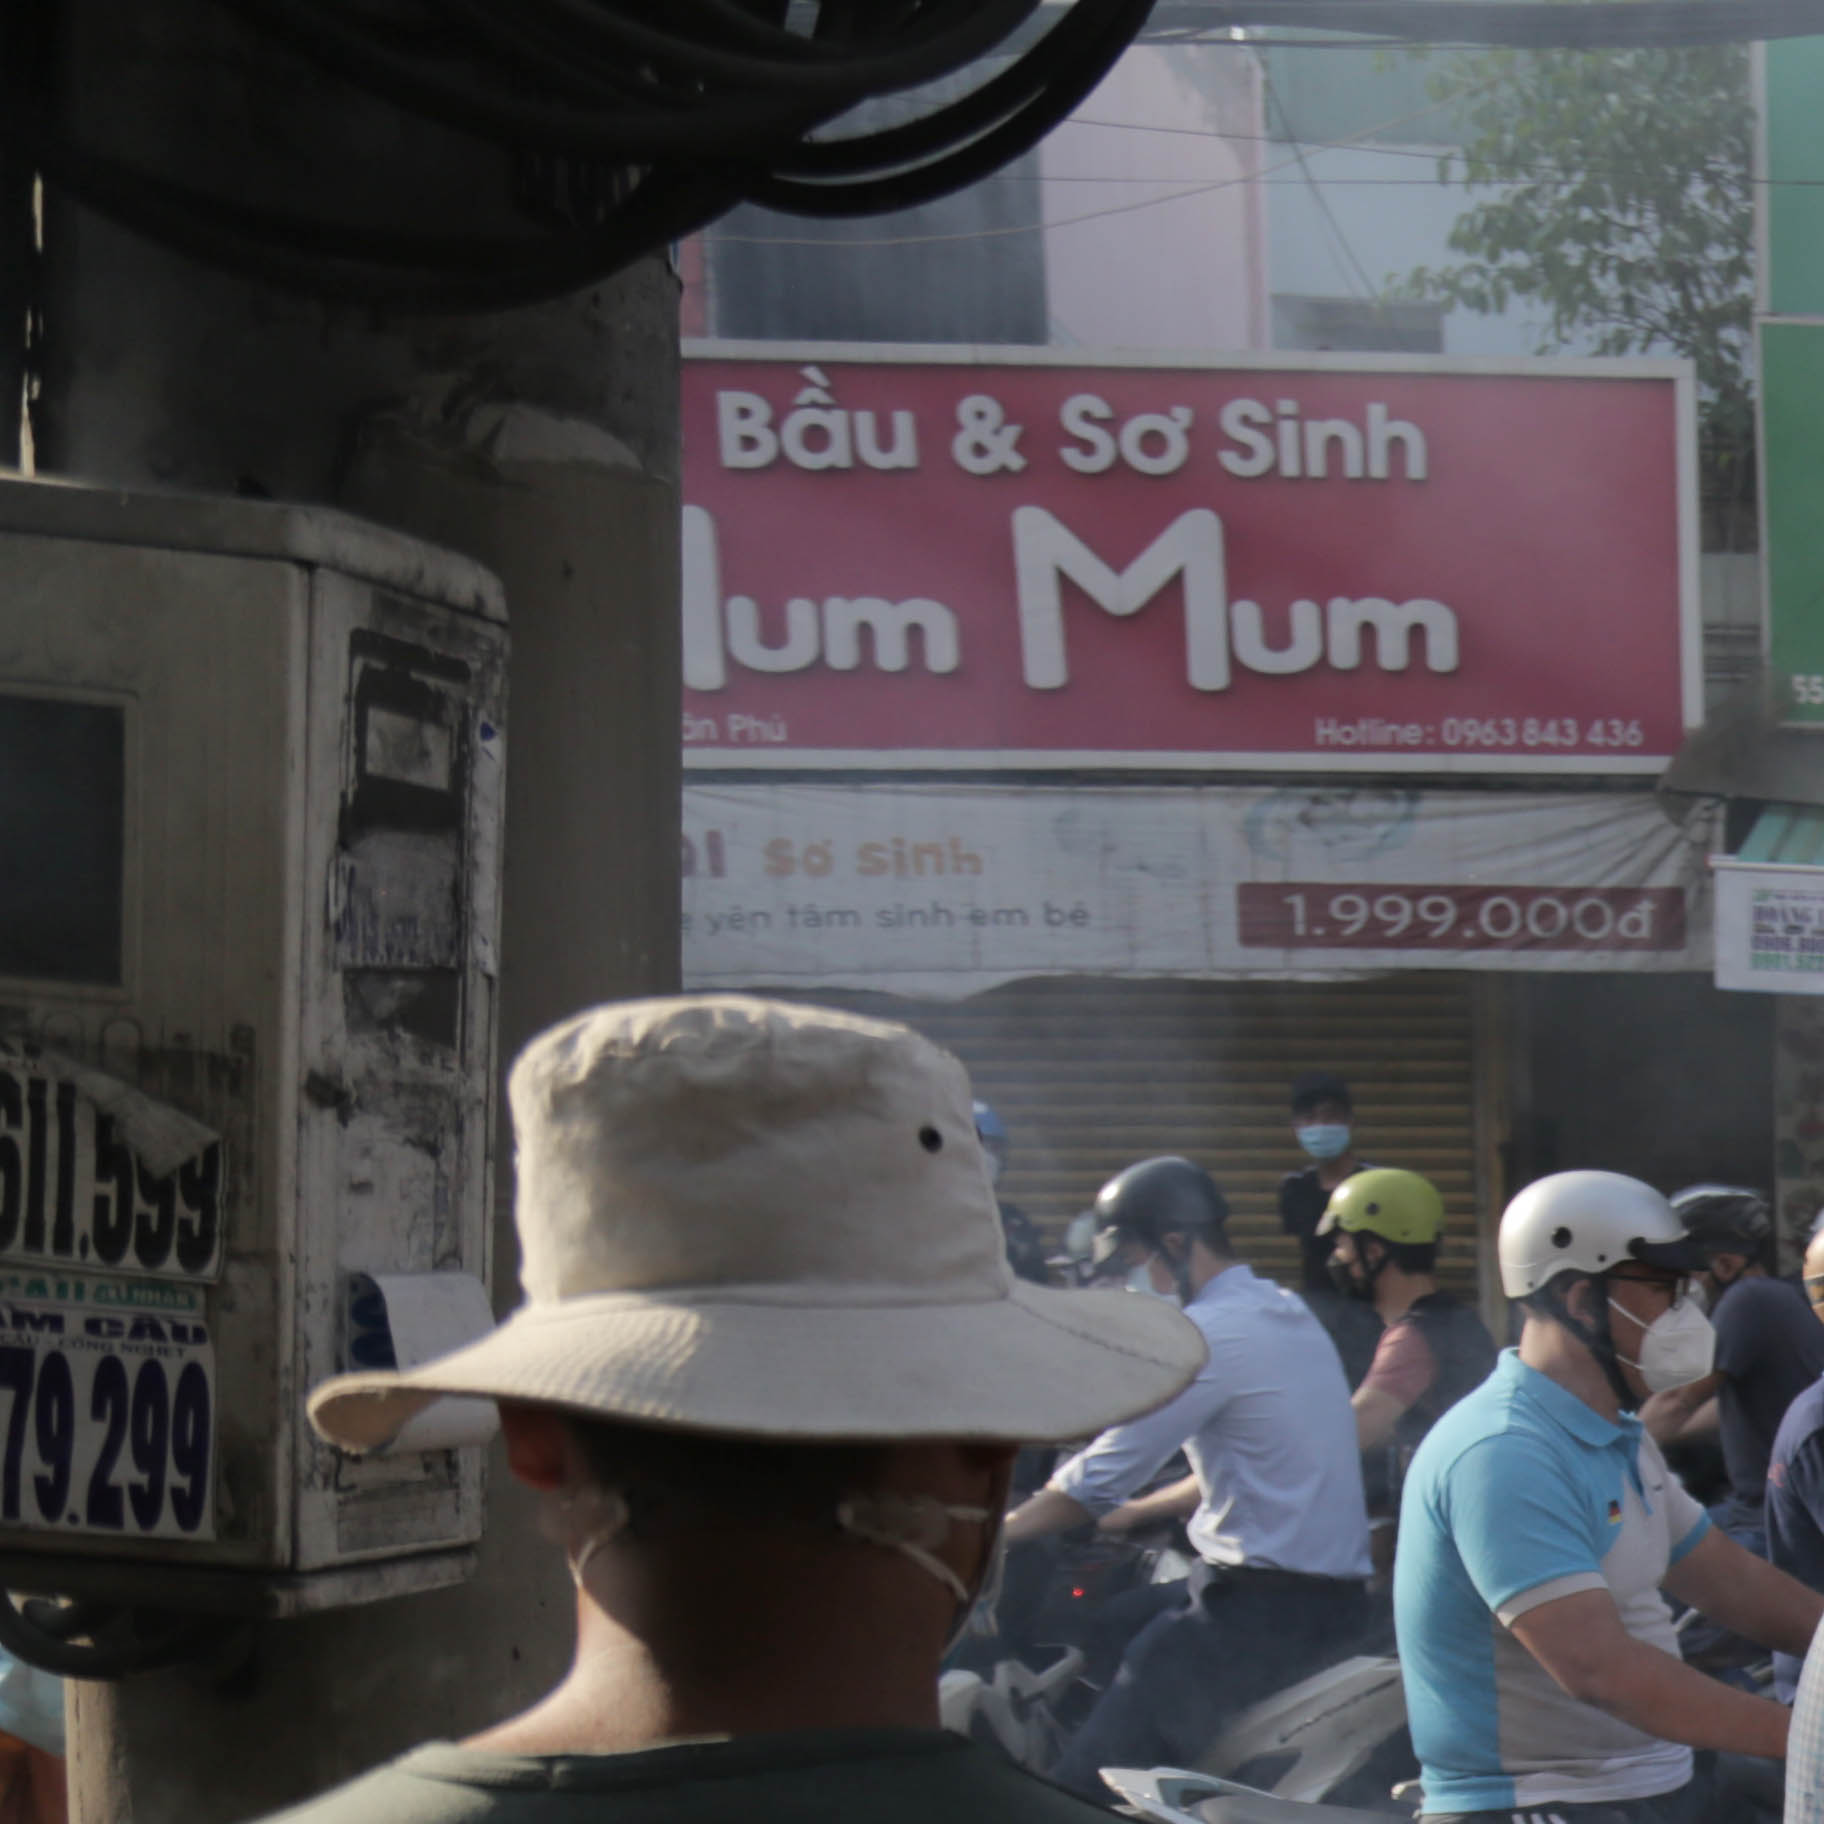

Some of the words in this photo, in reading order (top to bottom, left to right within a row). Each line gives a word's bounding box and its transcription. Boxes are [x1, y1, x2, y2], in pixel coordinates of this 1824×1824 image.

[716, 366, 918, 469] Bầu
[953, 395, 1028, 474] &
[1060, 395, 1192, 474] Sơ
[1218, 399, 1426, 480] Sinh
[682, 504, 960, 690] um
[1011, 506, 1458, 690] Mum
[1441, 717, 1518, 746] 0963
[1521, 718, 1578, 746] 843
[1586, 719, 1643, 747] 436
[876, 902, 954, 928] sinh
[1282, 892, 1659, 940] 1.999.000đ
